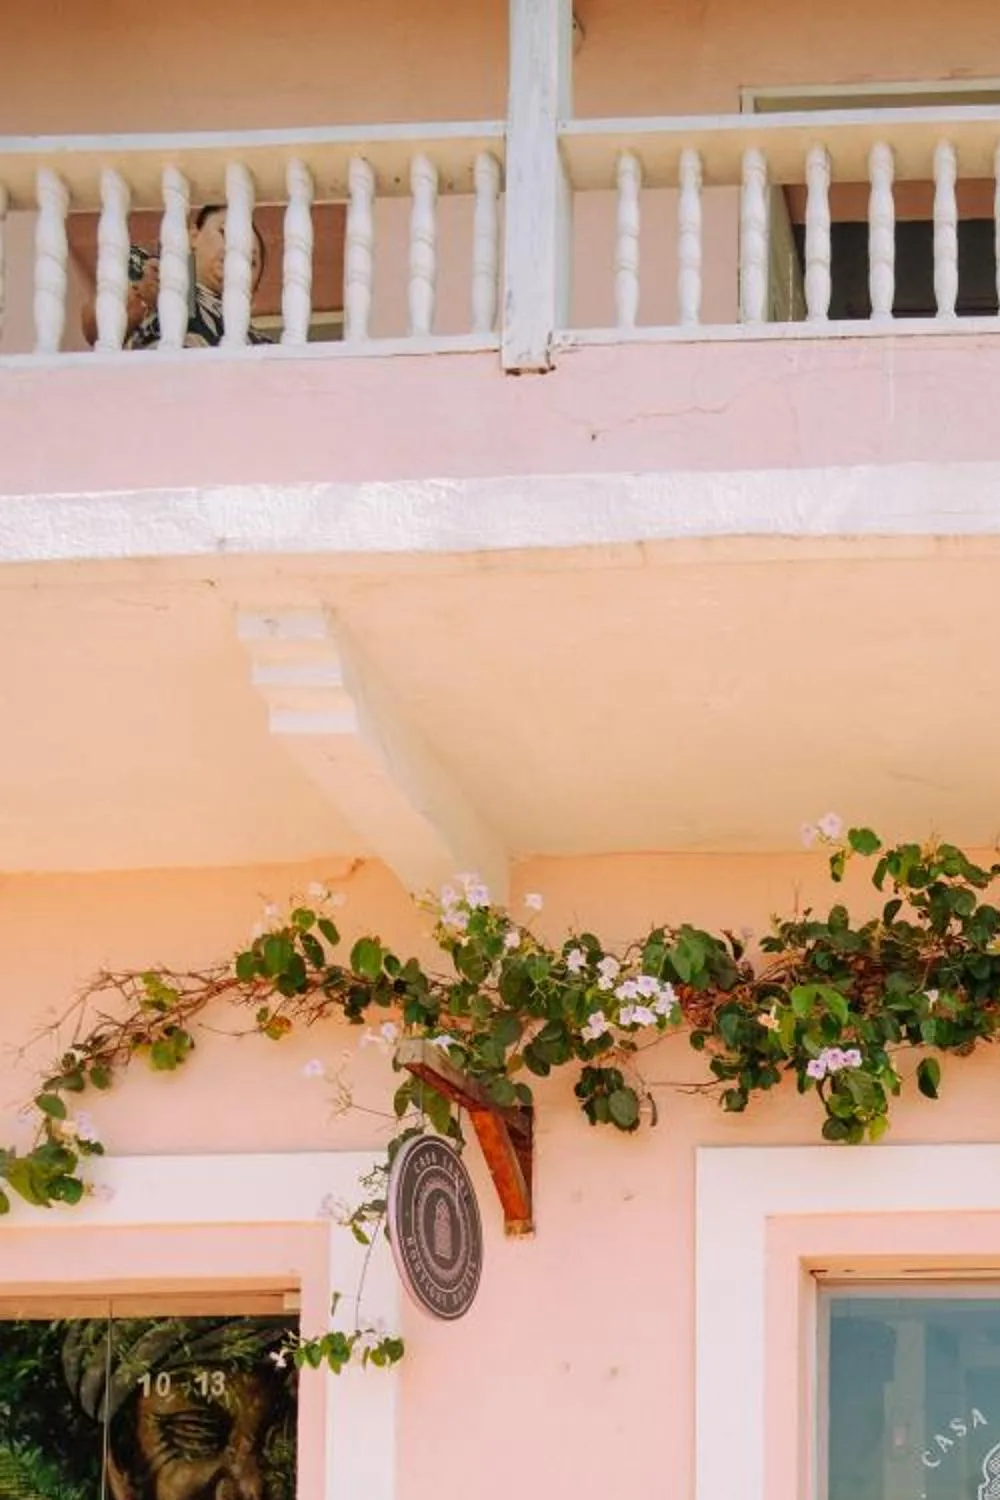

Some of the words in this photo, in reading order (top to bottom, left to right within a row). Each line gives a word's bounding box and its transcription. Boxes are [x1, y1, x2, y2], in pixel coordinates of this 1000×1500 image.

[137, 1371, 171, 1397] 10
[194, 1370, 226, 1397] 13
[920, 1407, 989, 1469] CASA
